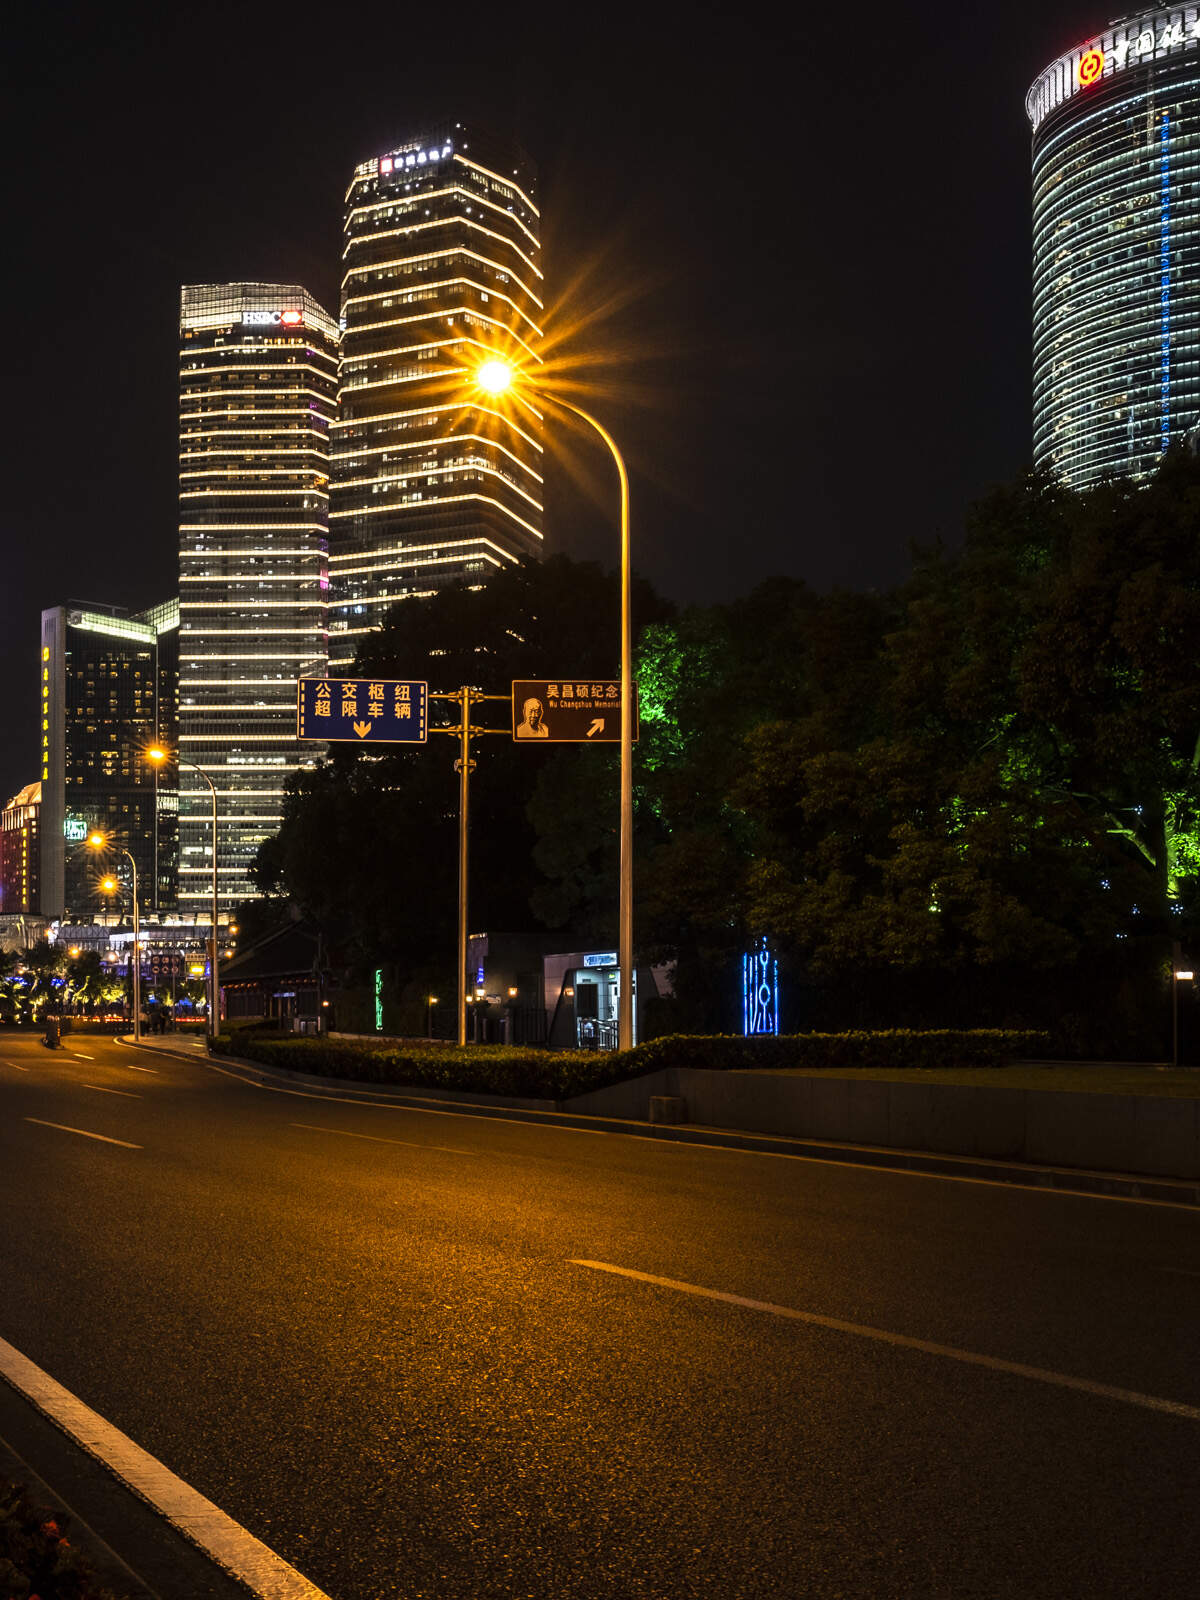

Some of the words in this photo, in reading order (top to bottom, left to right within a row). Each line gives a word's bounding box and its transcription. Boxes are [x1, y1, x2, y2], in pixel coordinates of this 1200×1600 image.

[315, 682, 411, 701] 公交枢纽
[546, 684, 619, 699] 吴昌硕纪念
[314, 700, 411, 719] 超限车辆
